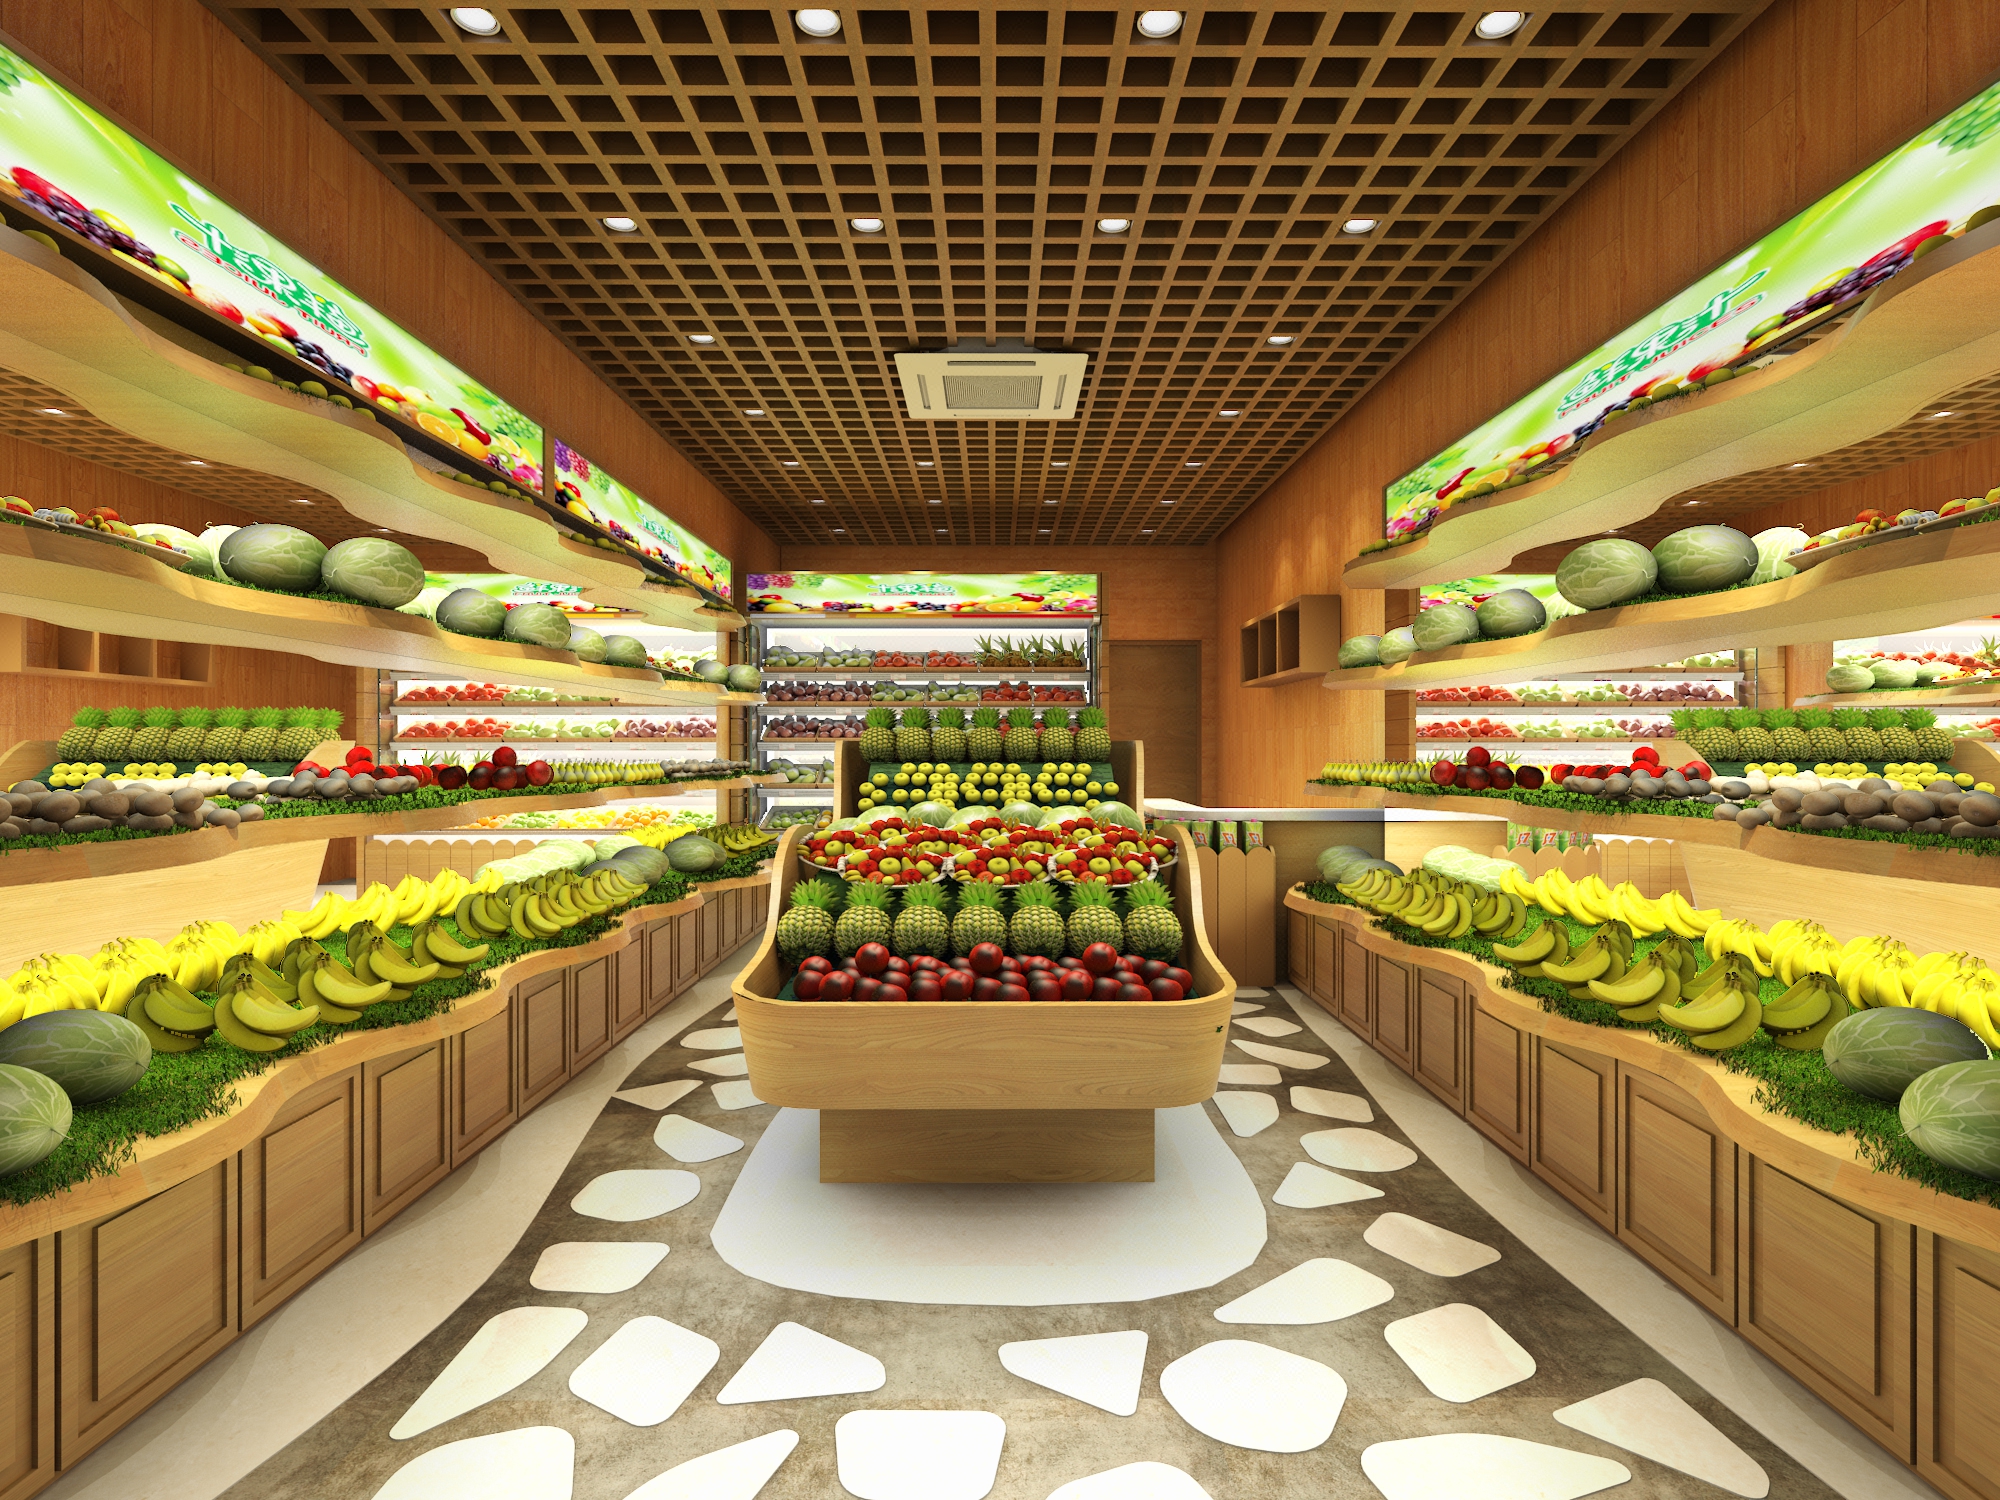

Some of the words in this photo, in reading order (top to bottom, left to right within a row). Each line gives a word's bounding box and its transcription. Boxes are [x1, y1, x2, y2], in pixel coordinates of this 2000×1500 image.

[1557, 267, 1770, 412] 鲜果汁
[1559, 372, 1630, 419] FRUIT
[1641, 298, 1758, 371] JUICES
